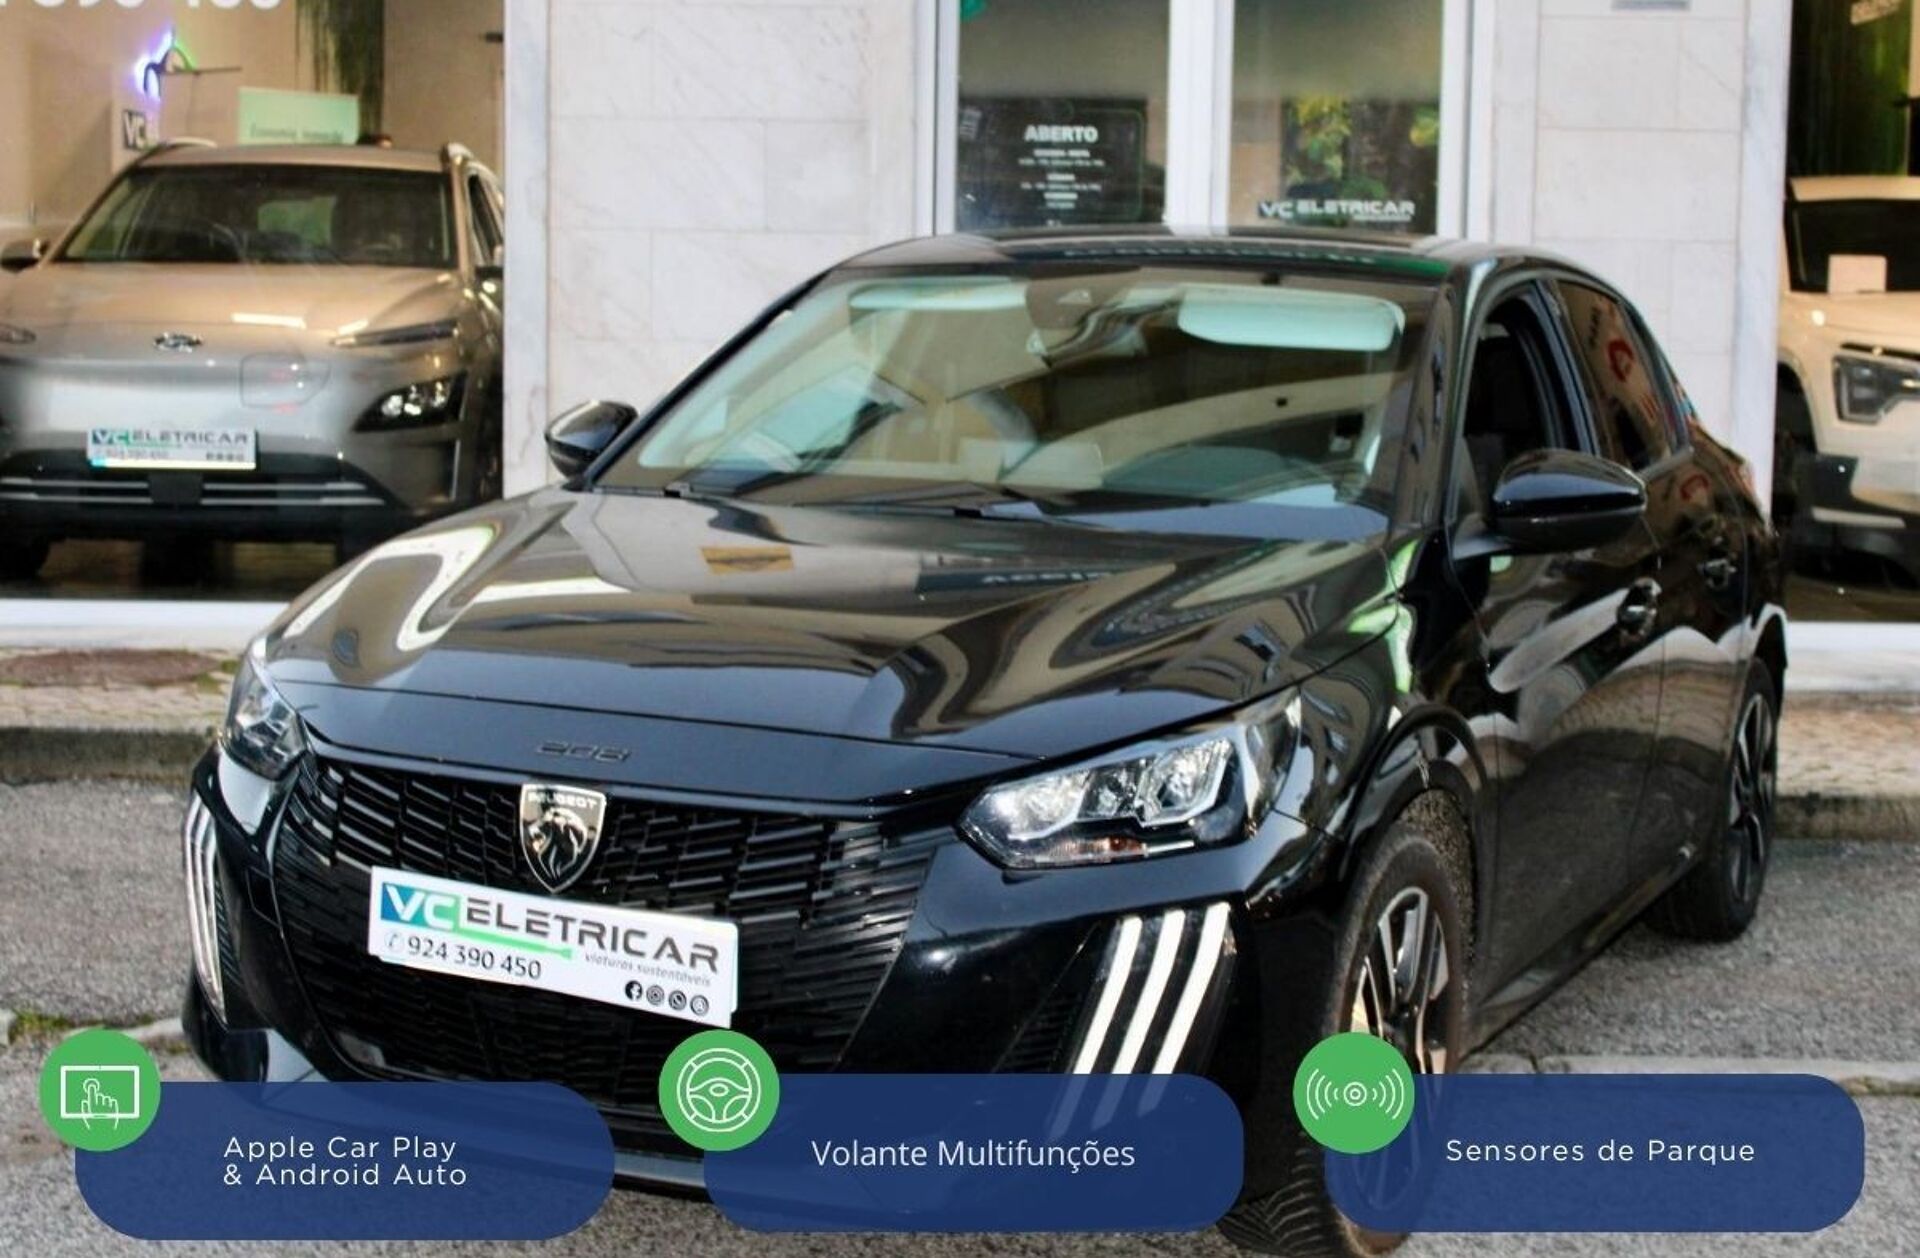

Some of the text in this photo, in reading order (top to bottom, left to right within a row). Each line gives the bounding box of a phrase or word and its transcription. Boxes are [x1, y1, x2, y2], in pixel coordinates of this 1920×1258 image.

[1024, 125, 1099, 142] ABERTO
[408, 935, 542, 980] 924 390 450
